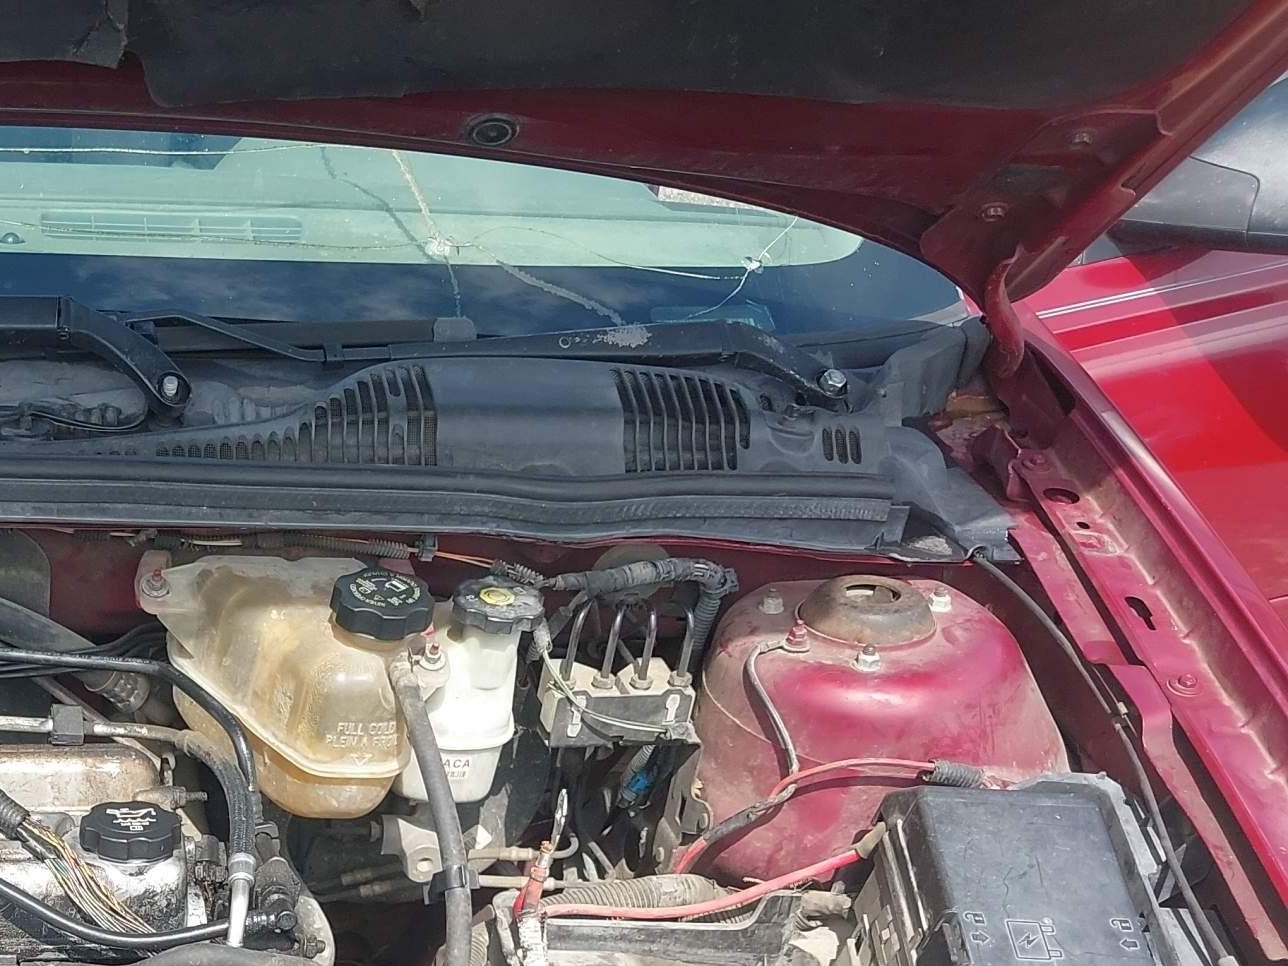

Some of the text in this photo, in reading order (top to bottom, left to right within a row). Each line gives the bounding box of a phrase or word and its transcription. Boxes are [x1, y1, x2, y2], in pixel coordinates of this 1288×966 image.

[336, 721, 397, 735] FULL COLD
[325, 734, 358, 746] PLEIN
